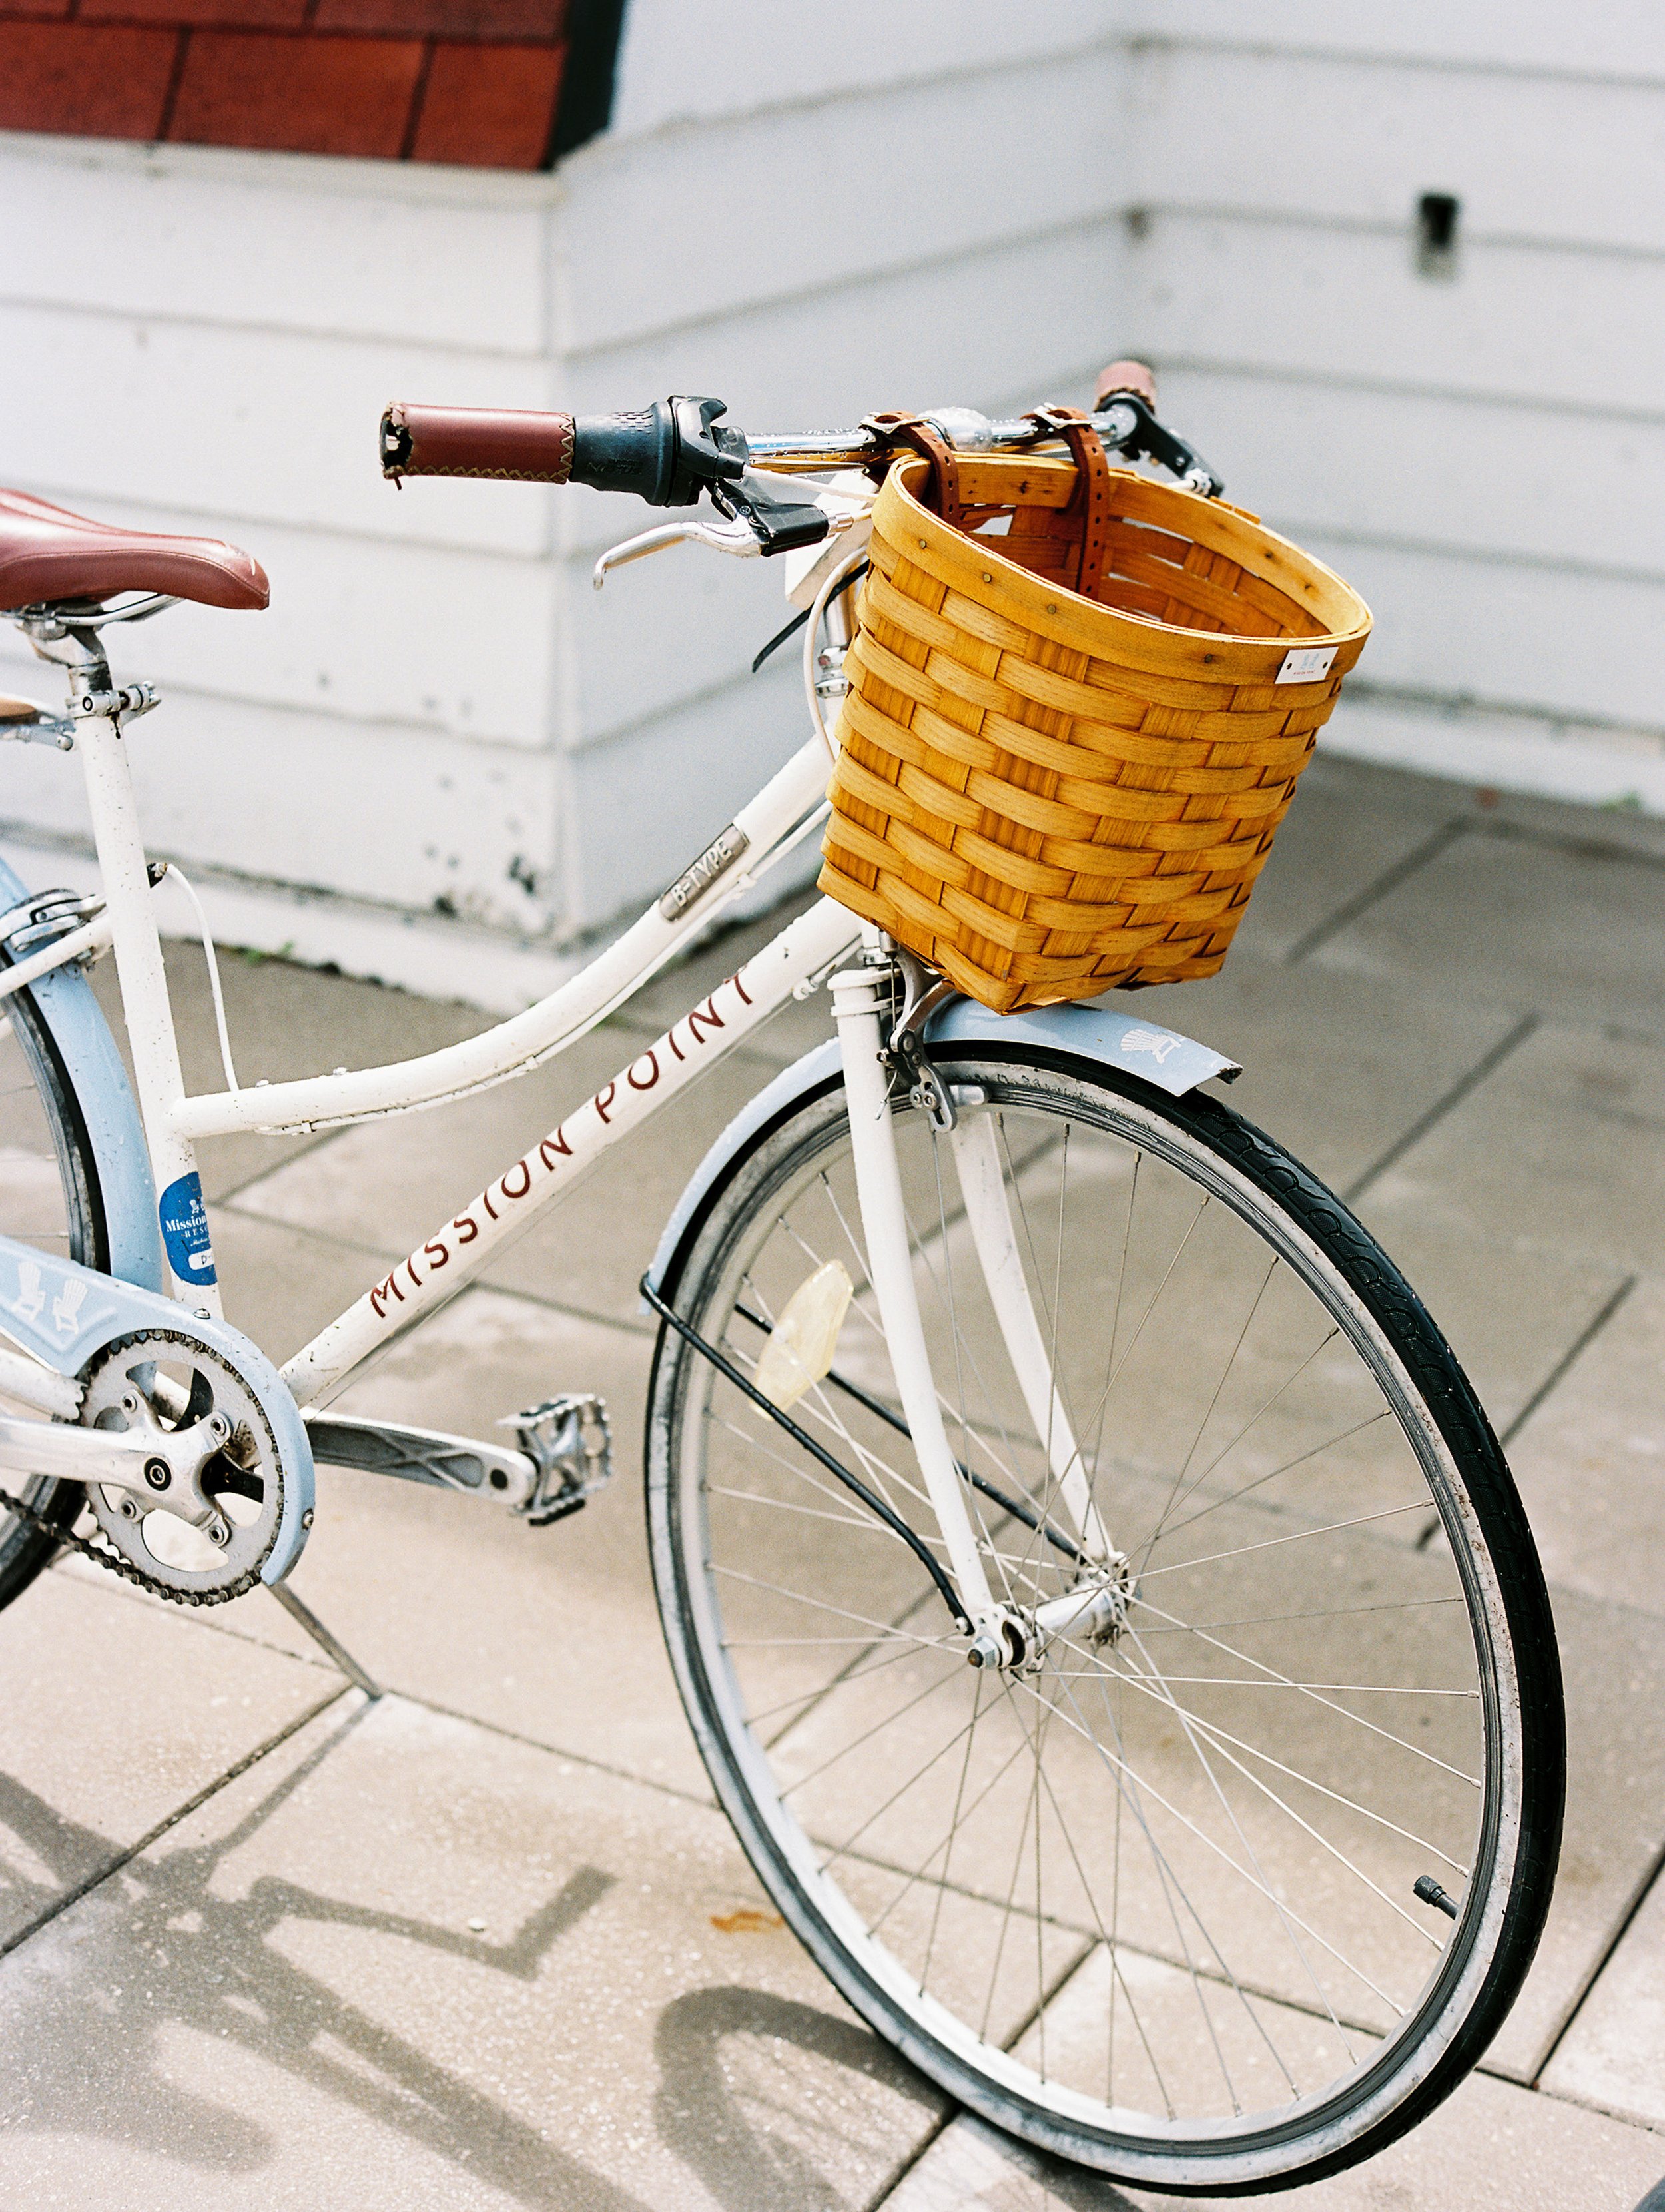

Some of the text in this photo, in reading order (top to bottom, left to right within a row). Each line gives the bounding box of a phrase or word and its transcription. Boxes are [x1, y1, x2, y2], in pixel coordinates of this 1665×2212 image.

[671, 837, 732, 907] B-TYPE
[370, 965, 753, 1318] MISSION POINT
